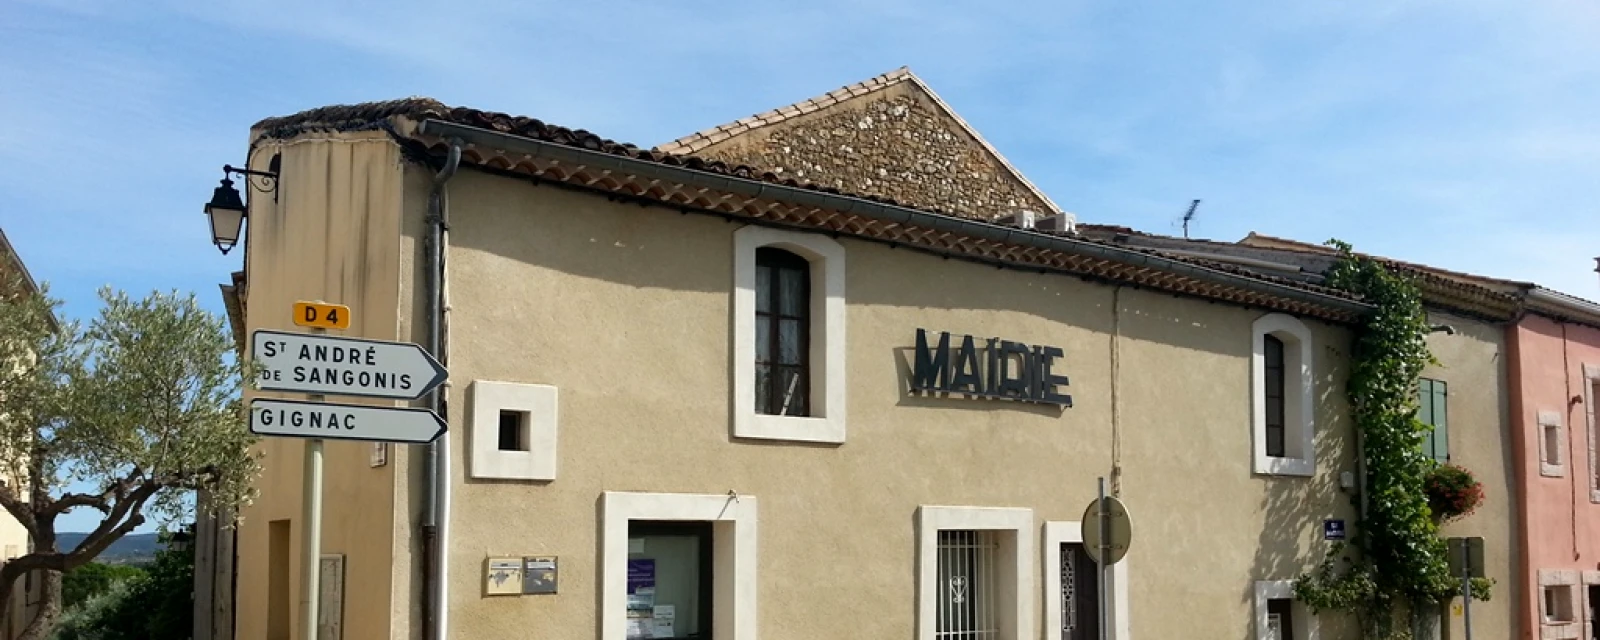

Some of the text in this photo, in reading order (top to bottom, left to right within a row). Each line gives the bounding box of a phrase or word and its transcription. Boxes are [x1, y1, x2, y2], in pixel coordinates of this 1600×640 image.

[305, 306, 339, 324] D 4
[298, 345, 377, 366] ANDRÉ
[914, 328, 1073, 405] MAIRIE
[262, 367, 412, 390] DE SANGONIS
[260, 409, 356, 430] GIGNAC
